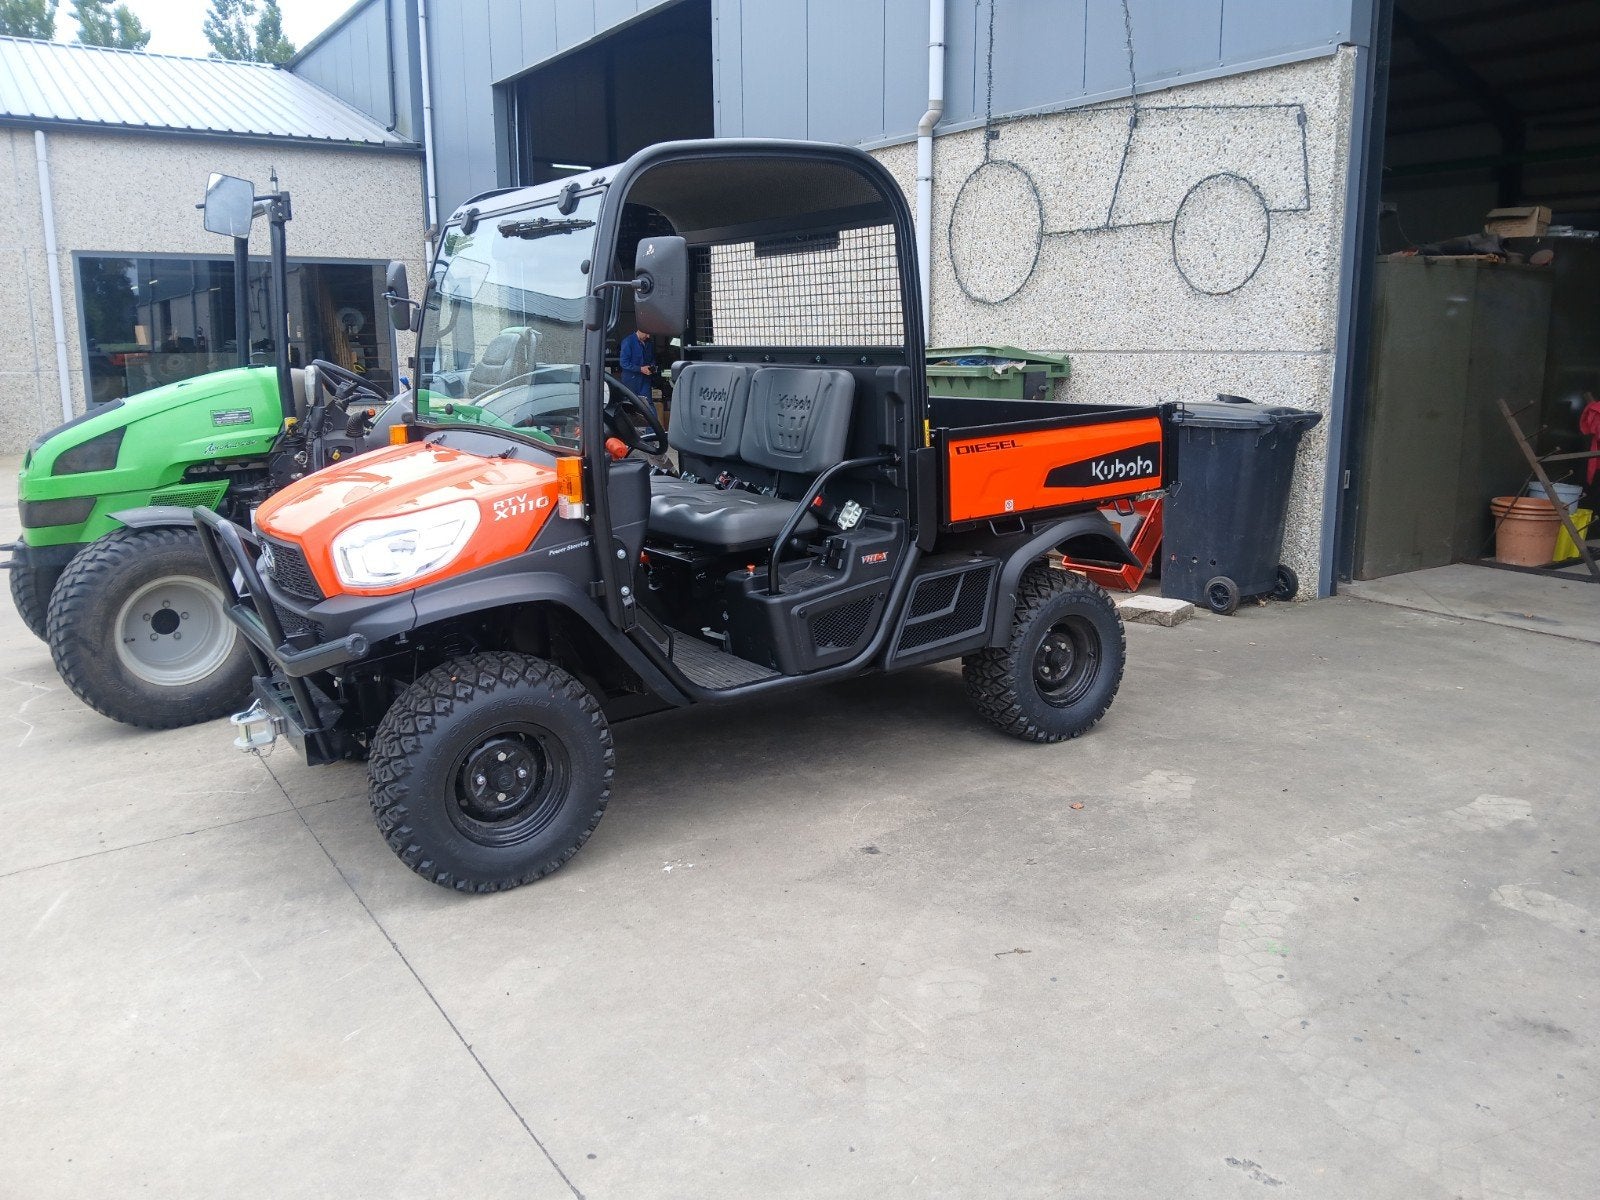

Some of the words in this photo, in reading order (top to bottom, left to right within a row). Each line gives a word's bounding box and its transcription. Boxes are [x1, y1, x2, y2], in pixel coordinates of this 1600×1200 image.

[955, 439, 1024, 456] DIESEL
[1091, 455, 1153, 481] Kubota
[493, 493, 528, 511] RTV
[494, 496, 550, 522] X1110
[548, 547, 567, 556] Power
[566, 540, 590, 552] Steering
